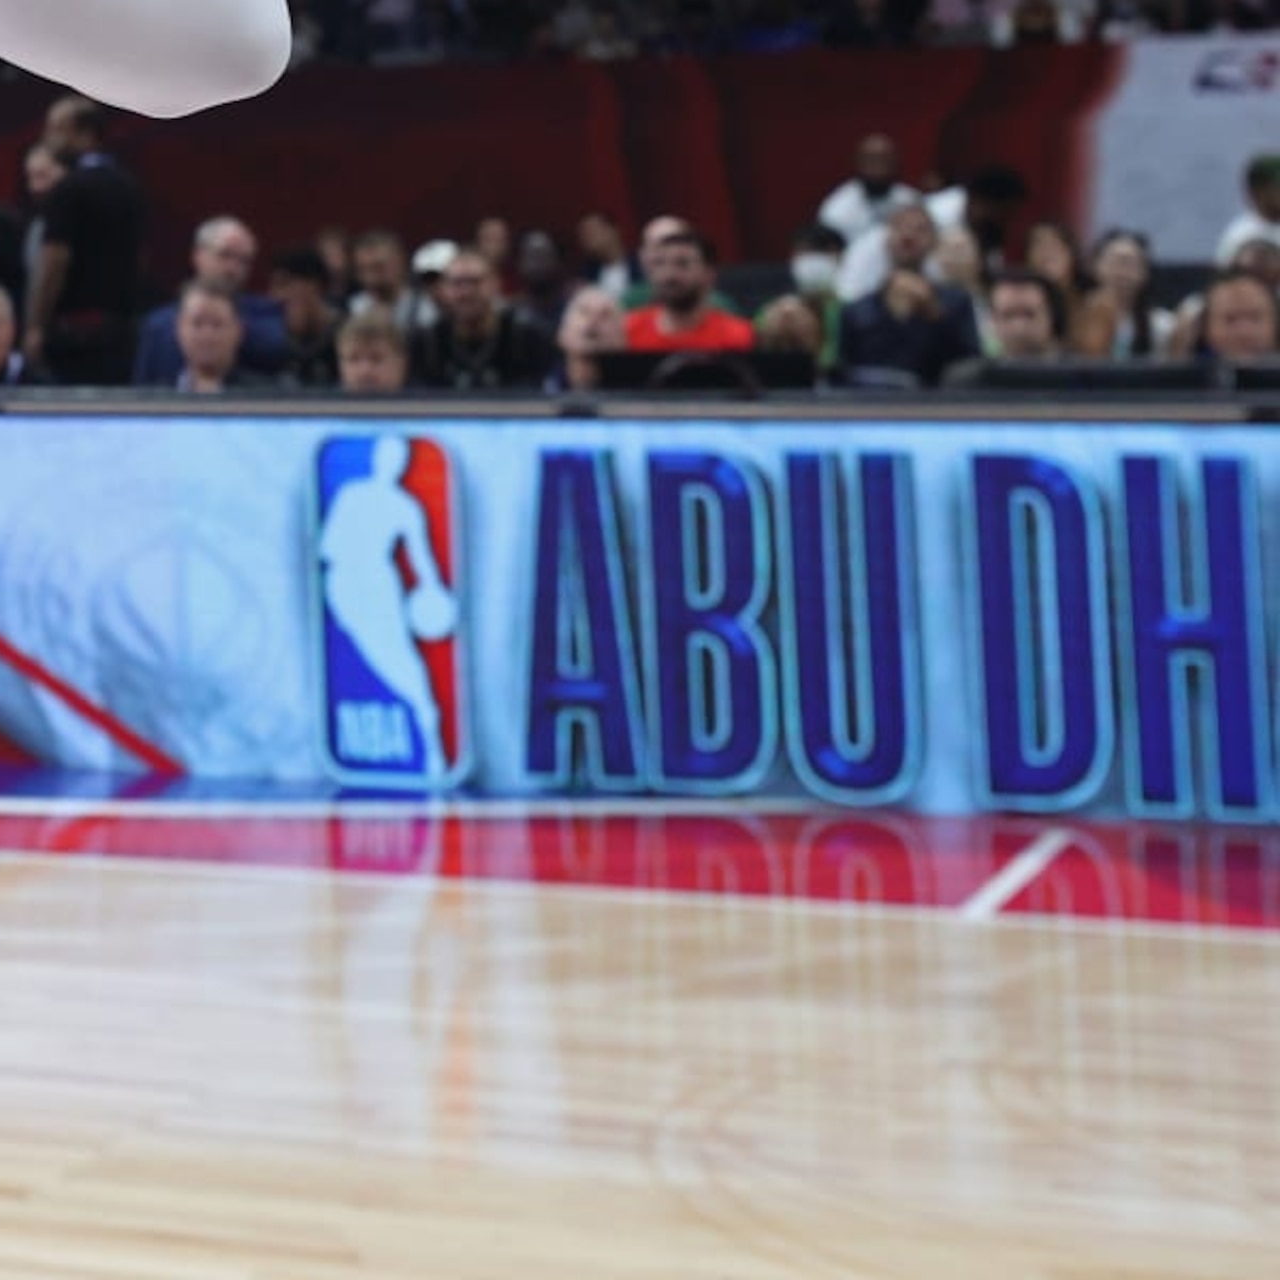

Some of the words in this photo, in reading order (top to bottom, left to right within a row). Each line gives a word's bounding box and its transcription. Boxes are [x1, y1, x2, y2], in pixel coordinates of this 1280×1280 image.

[336, 700, 414, 762] NBA
[522, 449, 922, 803] ABU
[970, 451, 1280, 822] DH
